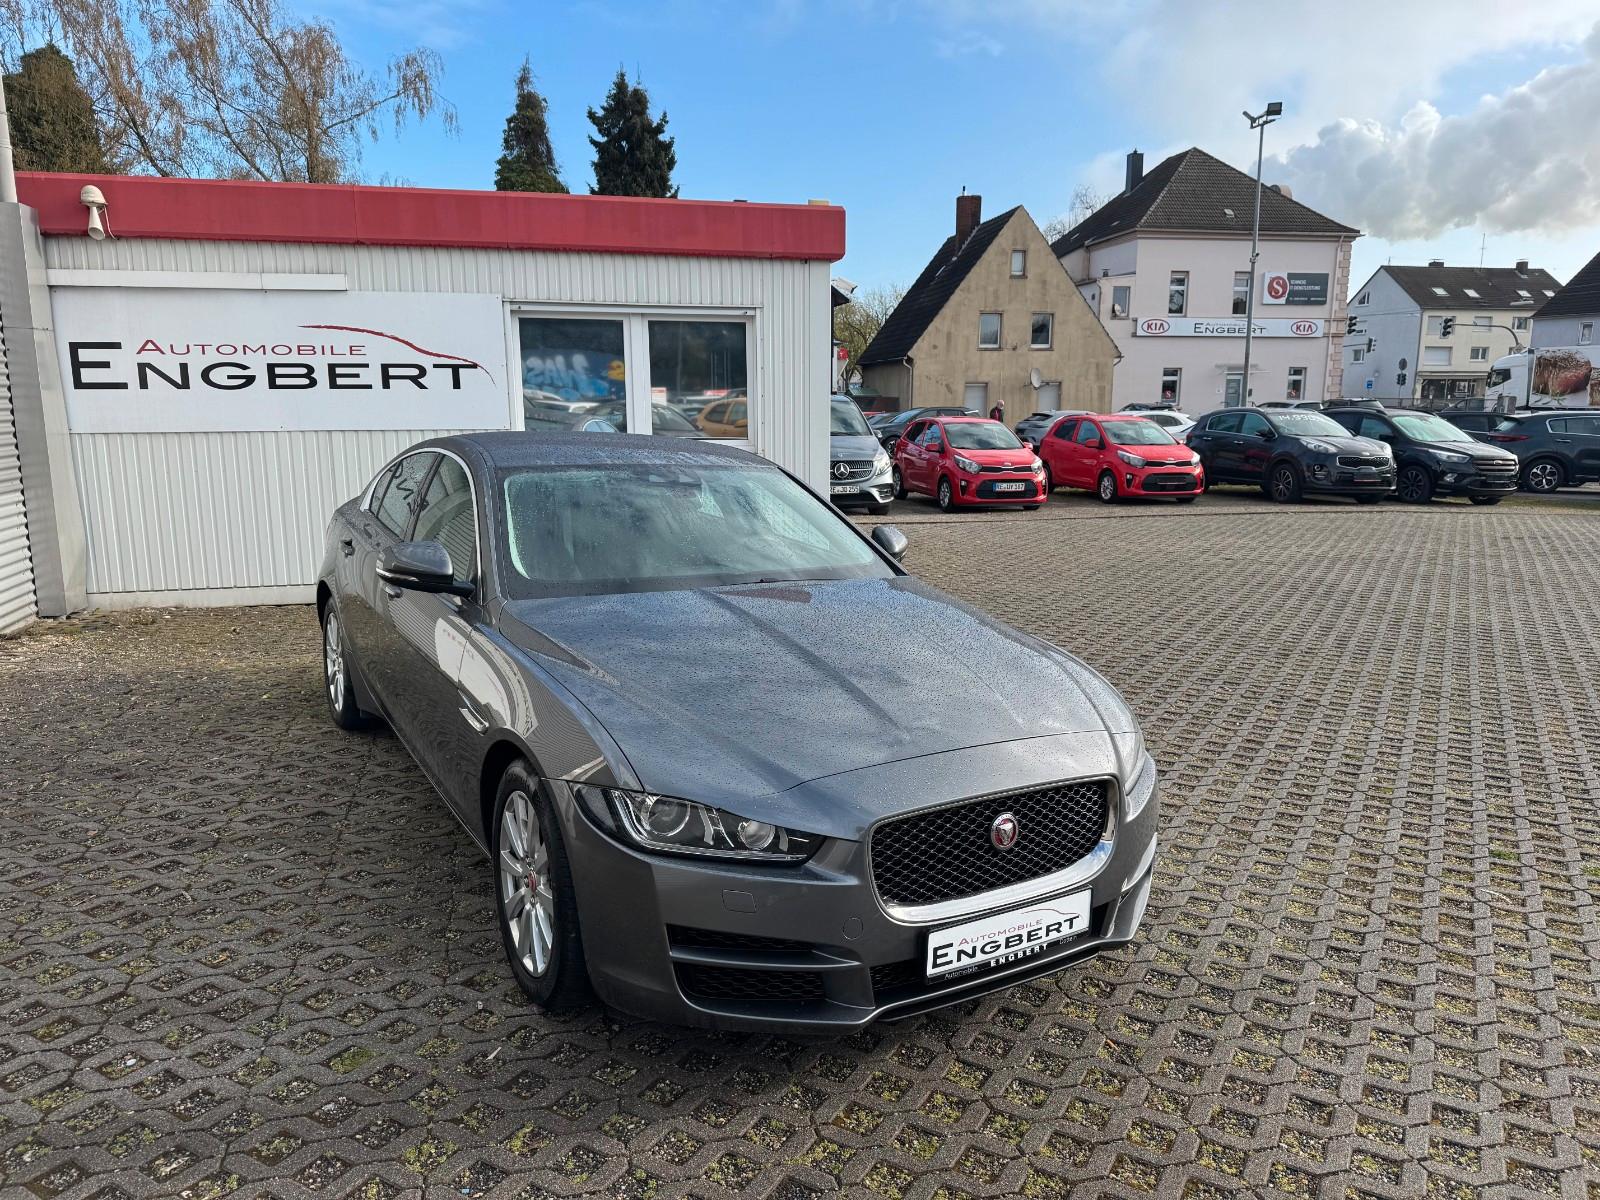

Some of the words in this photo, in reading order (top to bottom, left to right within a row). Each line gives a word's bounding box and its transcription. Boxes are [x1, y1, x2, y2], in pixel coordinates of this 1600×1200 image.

[1146, 322, 1165, 331] KIA
[1295, 323, 1313, 333] KIA
[136, 339, 366, 356] AUTOMOBILE
[68, 341, 478, 390] ENGBERT
[931, 914, 1080, 970] ENGBERT
[958, 918, 1043, 947] AUTOMOBILE
[990, 943, 1048, 968] ENGBERT
